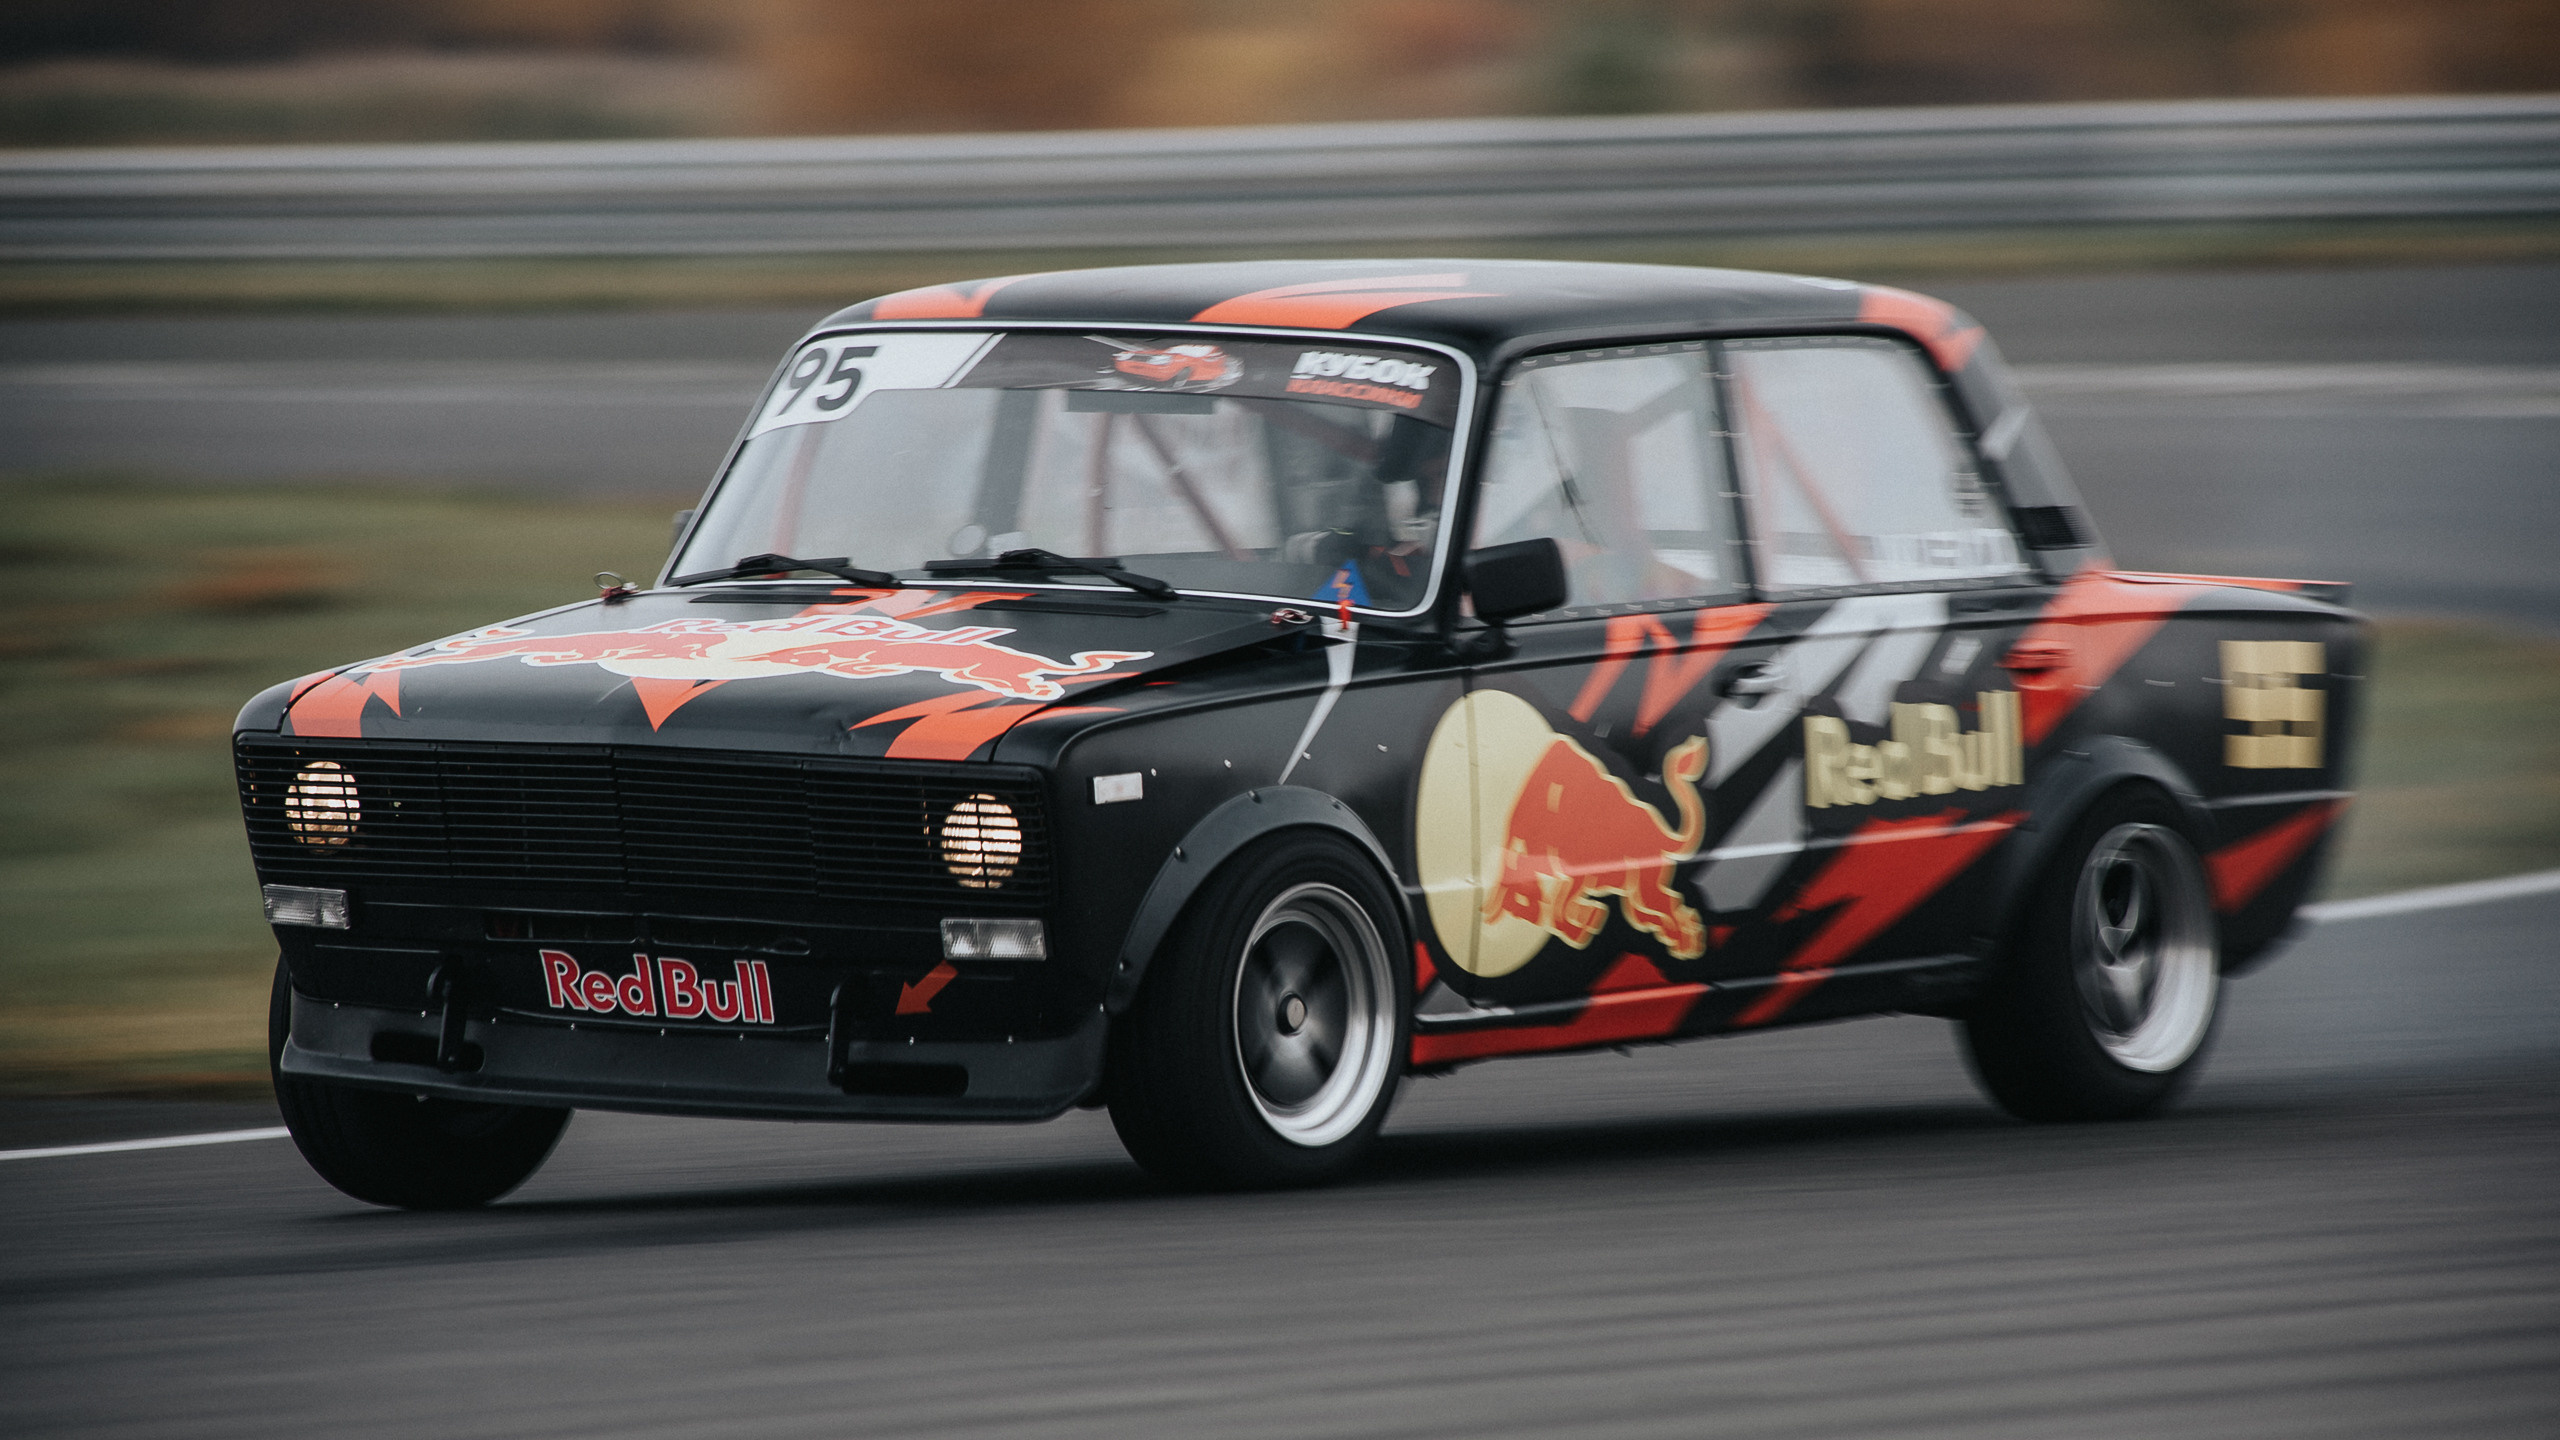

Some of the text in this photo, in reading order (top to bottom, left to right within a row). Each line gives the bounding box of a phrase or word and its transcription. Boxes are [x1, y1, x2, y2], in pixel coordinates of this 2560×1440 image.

[777, 345, 879, 417] 95
[636, 617, 1008, 645] Red Bull
[1803, 689, 2024, 808] Red Bull
[540, 950, 774, 1024] Red Bull
